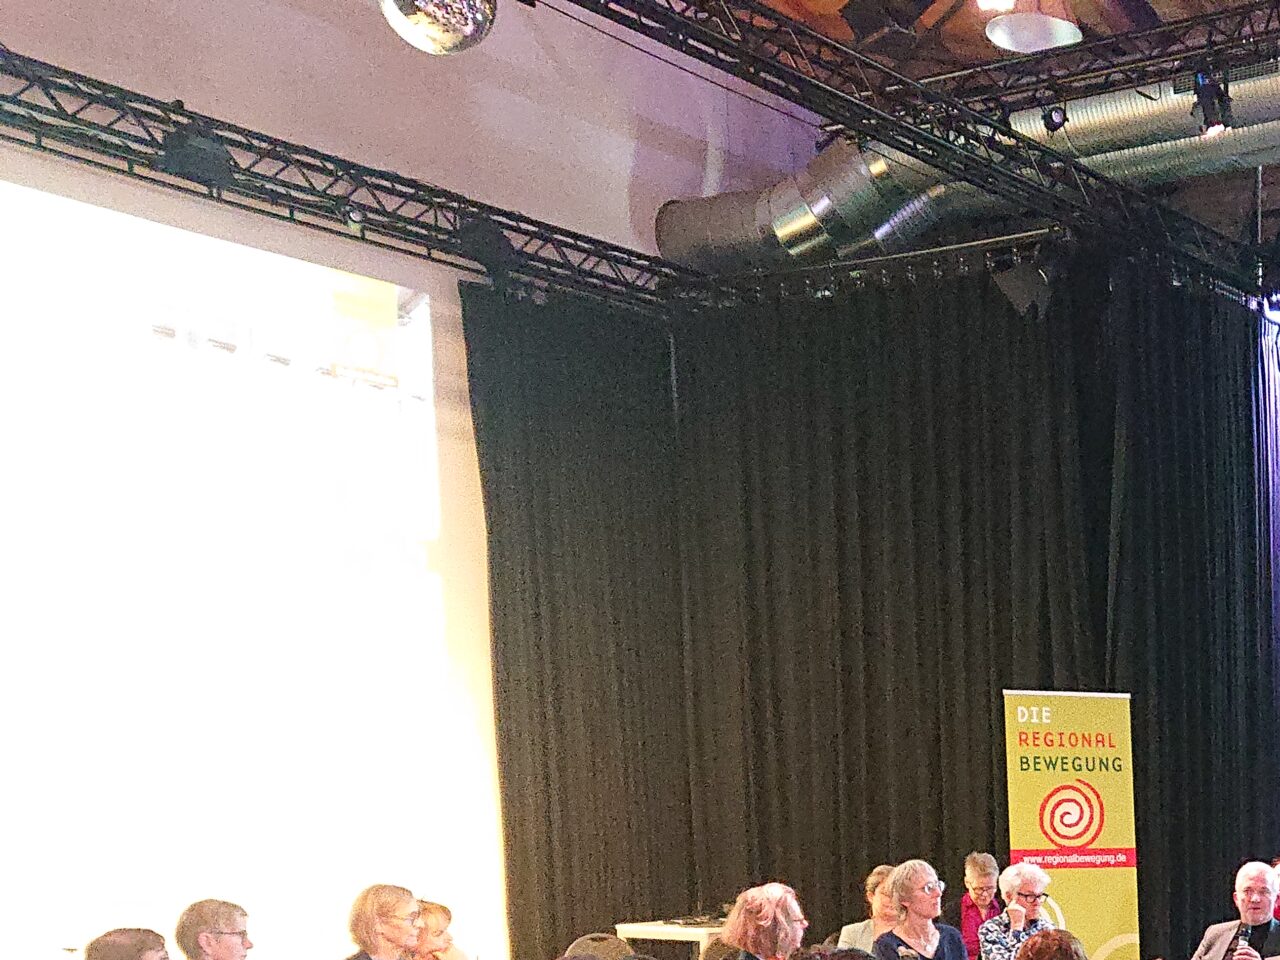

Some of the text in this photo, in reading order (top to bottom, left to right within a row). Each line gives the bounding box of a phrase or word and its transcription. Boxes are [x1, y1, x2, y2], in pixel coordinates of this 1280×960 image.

[1016, 705, 1052, 724] DIE
[1018, 731, 1117, 749] REGIONAL
[1019, 755, 1123, 772] BEWEGUNG
[1023, 852, 1127, 866] www.regionalbewegung.de
